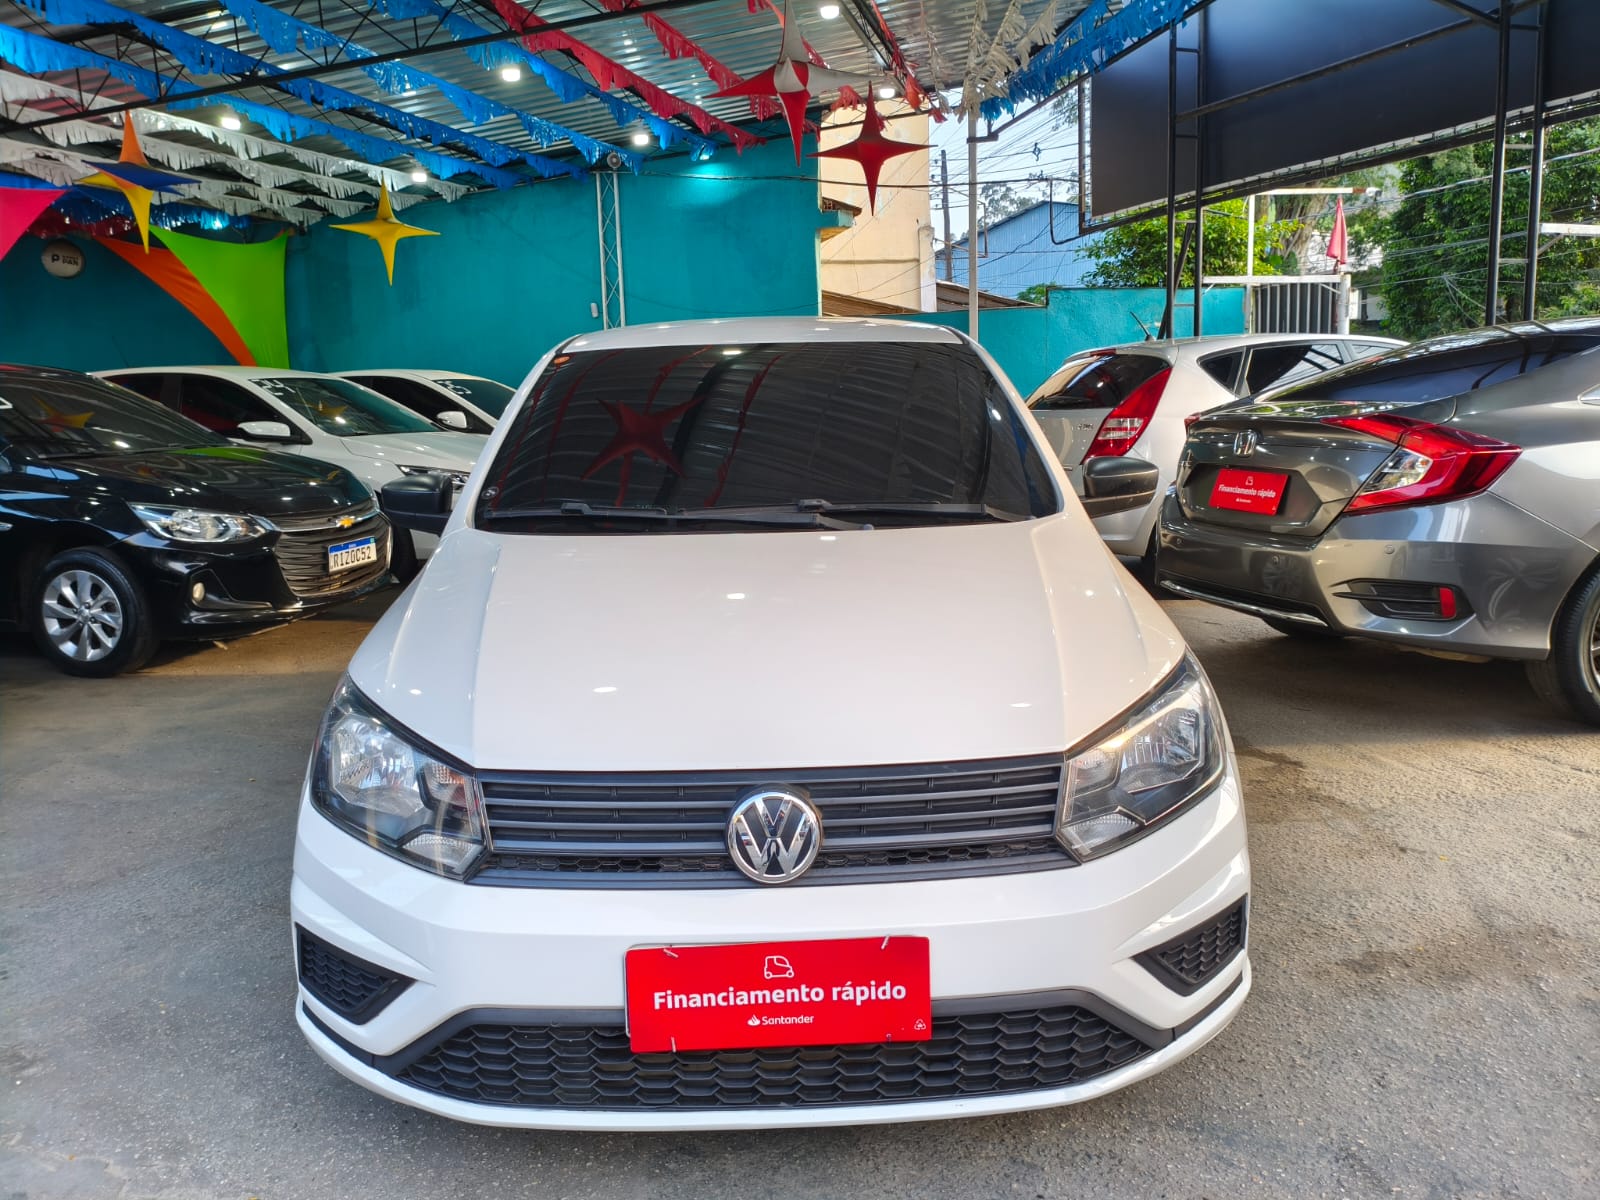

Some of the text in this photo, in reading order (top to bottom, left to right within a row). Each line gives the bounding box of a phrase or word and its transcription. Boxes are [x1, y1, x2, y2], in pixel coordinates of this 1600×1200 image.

[653, 980, 906, 1010] Financiamento rápido
[761, 1014, 815, 1026] Santander
